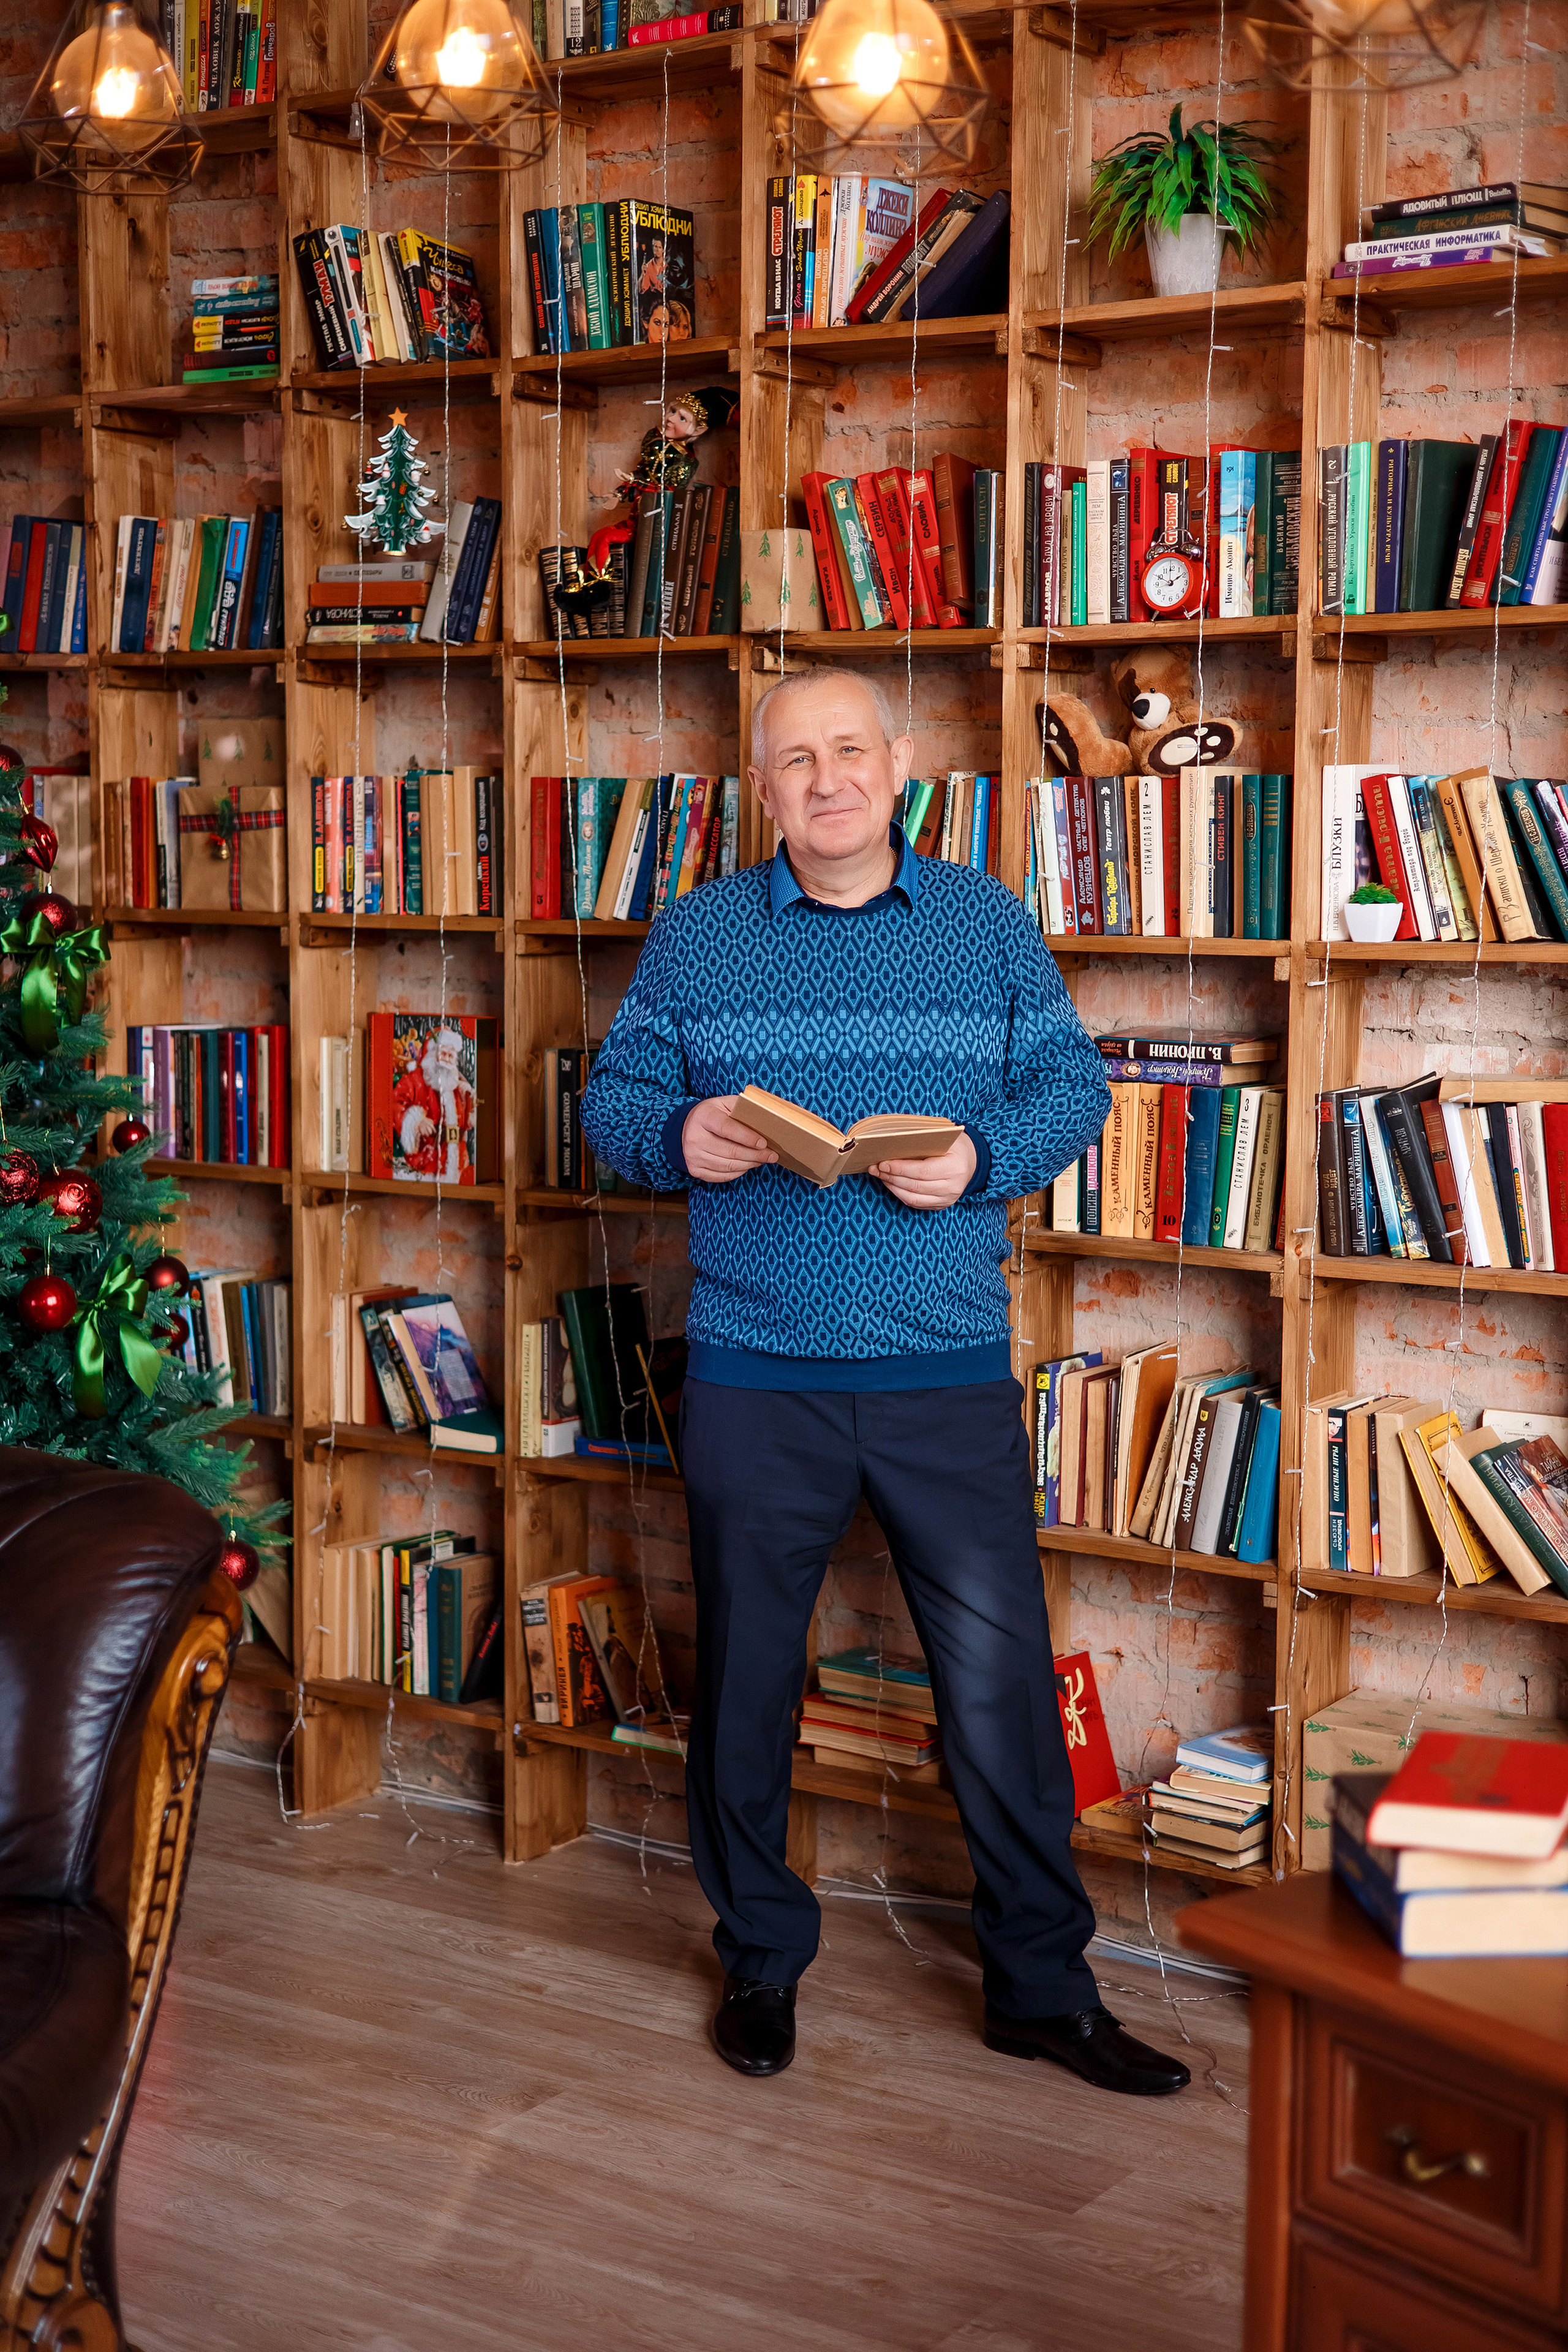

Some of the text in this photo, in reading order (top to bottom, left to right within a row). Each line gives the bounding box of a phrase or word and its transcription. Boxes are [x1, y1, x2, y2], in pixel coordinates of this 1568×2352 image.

[211, 40, 219, 87] ЧЕЛОВЕК
[263, 22, 276, 61] Гончаров
[630, 210, 692, 236] УБЛЮДКИ
[1402, 188, 1483, 214] ЯДОВИТЫЙ ПЛЮЩ
[619, 201, 630, 262] УБЛЮДКИ
[772, 206, 784, 257] СТРЕЛЯЮТ
[1366, 230, 1502, 256] ПРАКТИЧЕСКАЯ ИНФОРМАТИКА
[312, 257, 336, 309] ТУМАН
[532, 252, 541, 290] ПРЕЗИДЕНТА
[571, 262, 582, 289] ШАРНИ
[622, 267, 630, 299] ХЭММЕТ
[867, 270, 905, 315] АНДРЕЙ ВОРОНИН
[329, 302, 347, 352] СИРЕНЕВЫЙ
[586, 270, 603, 337] ДЖОЙ АДАМСОН
[1133, 475, 1141, 526] ДЕРЕВЯНКО
[1466, 448, 1489, 528] КУБАНЬ ДОБРОВОЛЬЧЕСКАЯ АРМИЯ
[1550, 463, 1562, 491] ТАБЛЕТОК
[891, 491, 907, 537] МИХАЙЛИК
[976, 483, 989, 543] СТЕНДАЛЬ
[1164, 492, 1179, 545] СТРЕЛЯЮТ
[1276, 514, 1284, 553] ВАСИЛИЙ
[1540, 508, 1551, 530] БЫСТРО
[869, 500, 901, 595] Иван СЕРБИН
[1117, 495, 1126, 605] АЛЕКСАНДРА МАРИНИНА
[1327, 493, 1338, 597] РУССКИЙ УГОЛОВНЫЙ РОМАН
[1474, 525, 1493, 578] КОРЕЦКИЙ
[1531, 545, 1541, 566] СНЯТЬ
[1536, 531, 1545, 546] БОЛЬ
[822, 566, 832, 602] КАРАЕВ
[315, 784, 324, 832] ДАШКОВА
[1129, 786, 1137, 815] ВОЛК
[1144, 782, 1150, 797] 2
[1217, 791, 1226, 862] СТИВЕН КИНГ
[1372, 784, 1392, 845] Кристи
[1401, 827, 1410, 845] водой
[1443, 796, 1463, 837] Эммануэль
[665, 835, 675, 861] СЕКРЕТ
[1131, 821, 1140, 869] МОРСКОЙ
[1142, 803, 1153, 875] СТАНИСЛАВ ЛЕМ
[1331, 816, 1343, 870] БЛУЗКИ
[480, 856, 491, 910] Корецкий
[1084, 854, 1094, 905] КУЗНЕЦОВ
[1408, 858, 1420, 892] Атлантида
[1107, 897, 1120, 927] Барбара
[1149, 1043, 1223, 1061] В. ПРОНИН
[1166, 1095, 1179, 1151] Кристи
[1244, 1098, 1250, 1112] 3
[562, 1091, 571, 1177] СОМЕРСЕТ МОЭМ
[1110, 1101, 1123, 1204] КАМЕННЫЙ ПОЯС
[1144, 1103, 1156, 1210] КАМЕННЫЙ ПОЯС
[1233, 1118, 1250, 1189] СТАНИСЛАВ ЛЕМ
[1087, 1145, 1099, 1226] ПОЛИНА ДАШКОВА
[1253, 1112, 1274, 1227] БИБЛИОТЕЧКА ОРЛЕНОК
[1329, 1168, 1337, 1189] ИДЕТ
[1351, 1128, 1366, 1238] АЛЕКСАНДРА МАРИНИНА
[1513, 1172, 1523, 1206] СЕКРЕТ
[1162, 1215, 1177, 1226] 10
[1180, 1427, 1207, 1523] АЛЕКСАНДР ДЮМА
[1539, 1456, 1563, 1472] ТАЙНЫ
